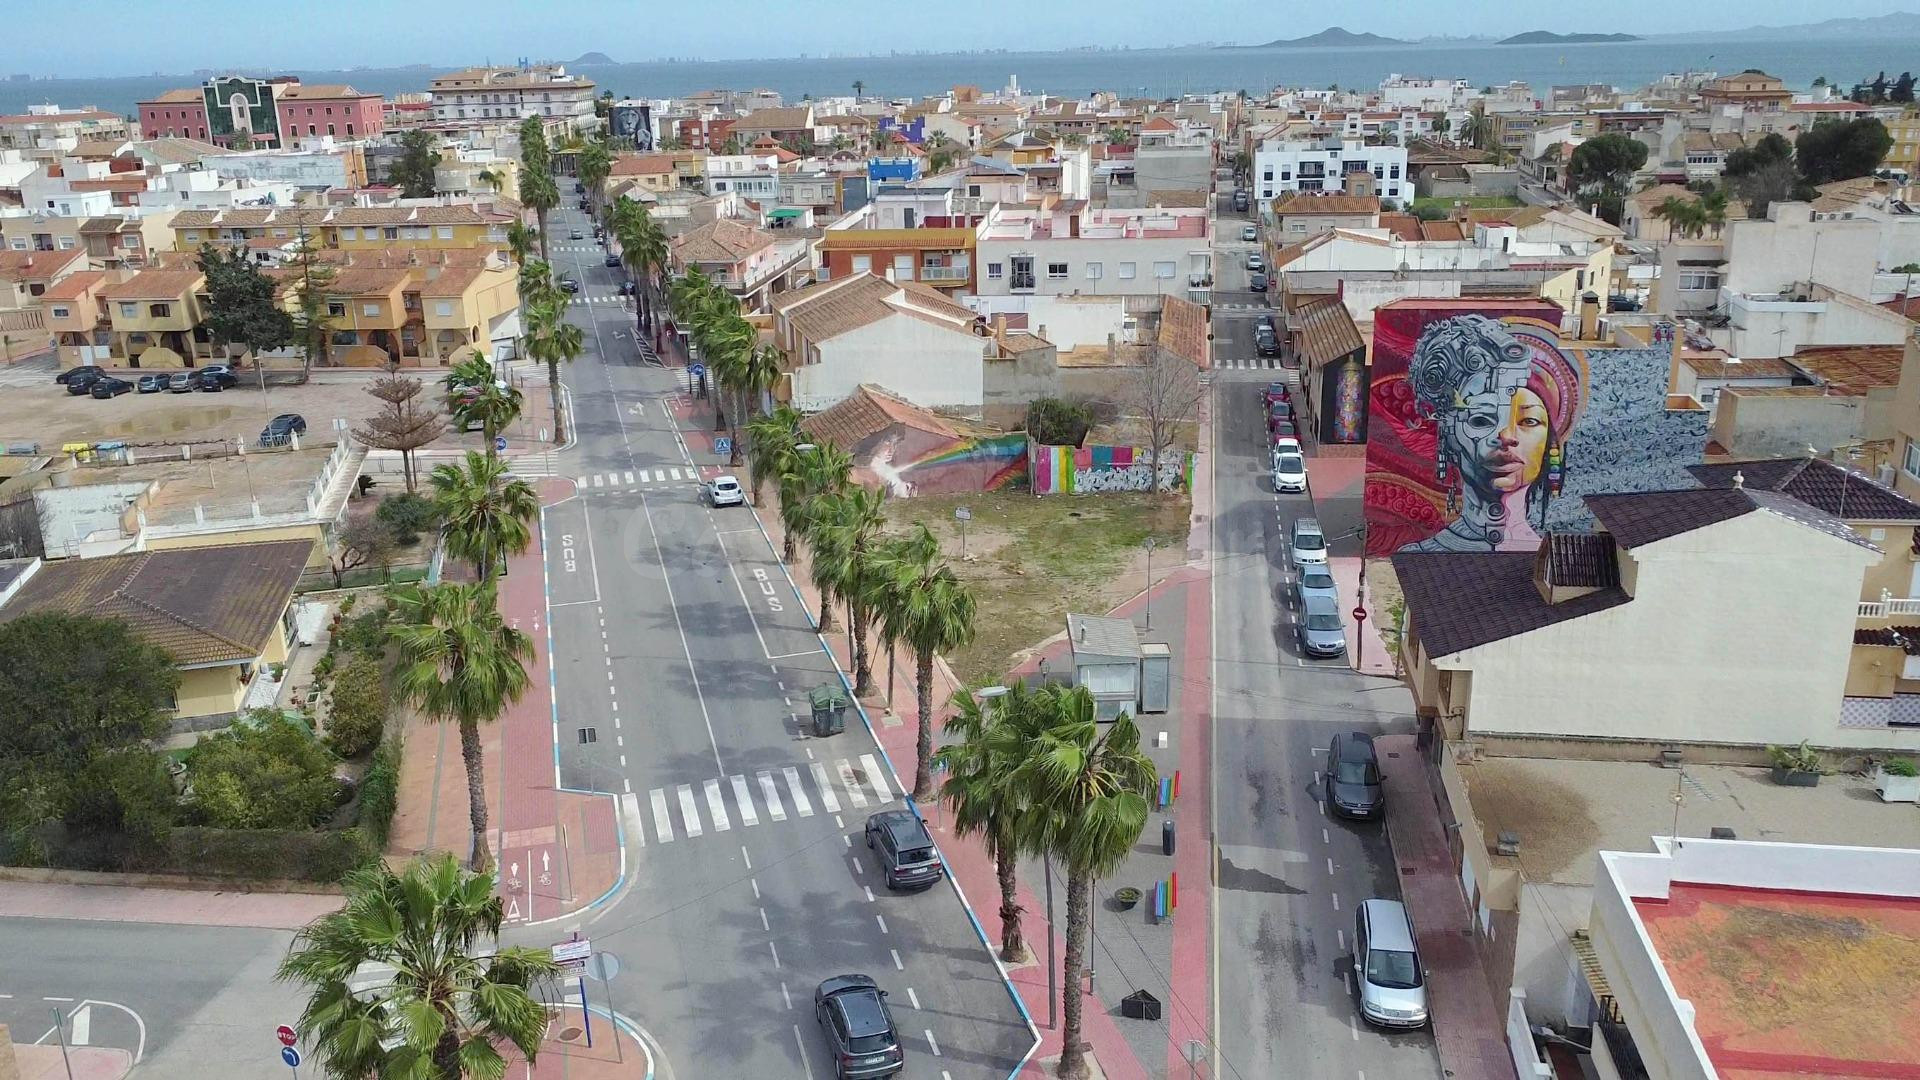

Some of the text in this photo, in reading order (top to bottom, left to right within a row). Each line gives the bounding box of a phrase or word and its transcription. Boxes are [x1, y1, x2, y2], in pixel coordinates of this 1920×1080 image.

[562, 534, 576, 572] BUS
[752, 568, 783, 612] BUS
[278, 1031, 296, 1040] STOP
